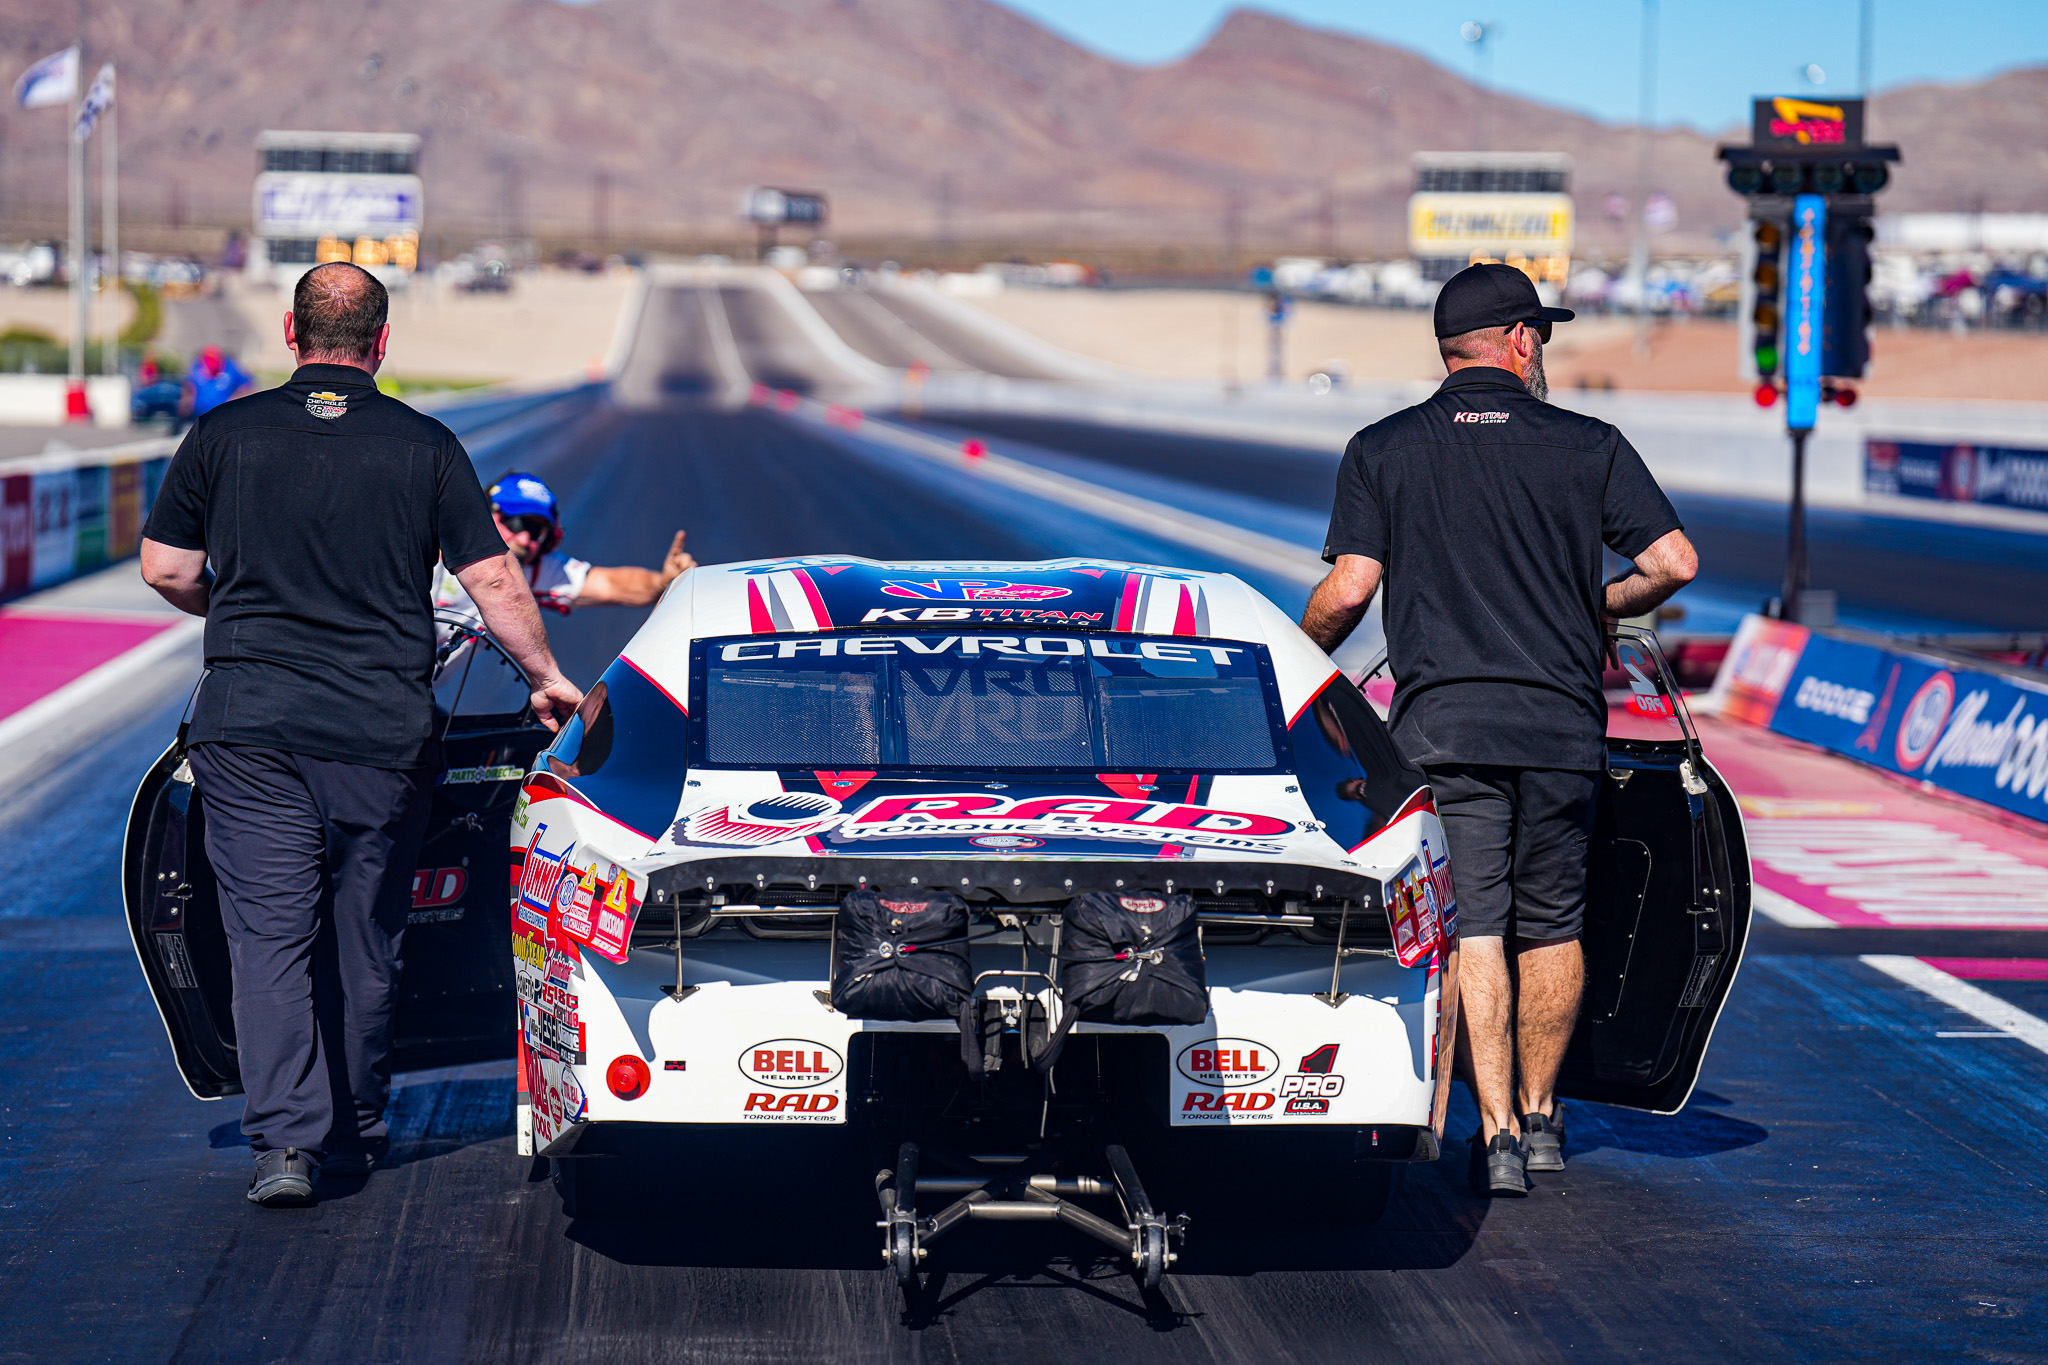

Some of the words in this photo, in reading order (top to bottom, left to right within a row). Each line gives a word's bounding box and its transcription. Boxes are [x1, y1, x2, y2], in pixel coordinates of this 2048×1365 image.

[307, 398, 347, 406] CHEVROLET
[1453, 412, 1479, 423] KB
[1480, 412, 1509, 420] TITAN
[883, 578, 1012, 600] VP
[861, 607, 974, 622] KB
[975, 608, 1103, 621] TITAN
[982, 617, 1090, 626] RACING
[722, 637, 1244, 665] CHEVROLET
[854, 795, 1295, 837] RAD
[850, 823, 1046, 835] TORQUE
[1054, 825, 1288, 853] SYSTEMS
[411, 866, 469, 908] AD
[569, 918, 590, 935] CHALLENGE
[598, 910, 624, 940] MISSION
[753, 1050, 830, 1073] BELL
[1191, 1049, 1266, 1072] BELL
[1298, 1044, 1340, 1074] 1
[1279, 1075, 1344, 1097] PRO
[743, 1093, 839, 1112] RAD
[1182, 1092, 1276, 1111] RAD
[1292, 1102, 1323, 1110] U.S.A.
